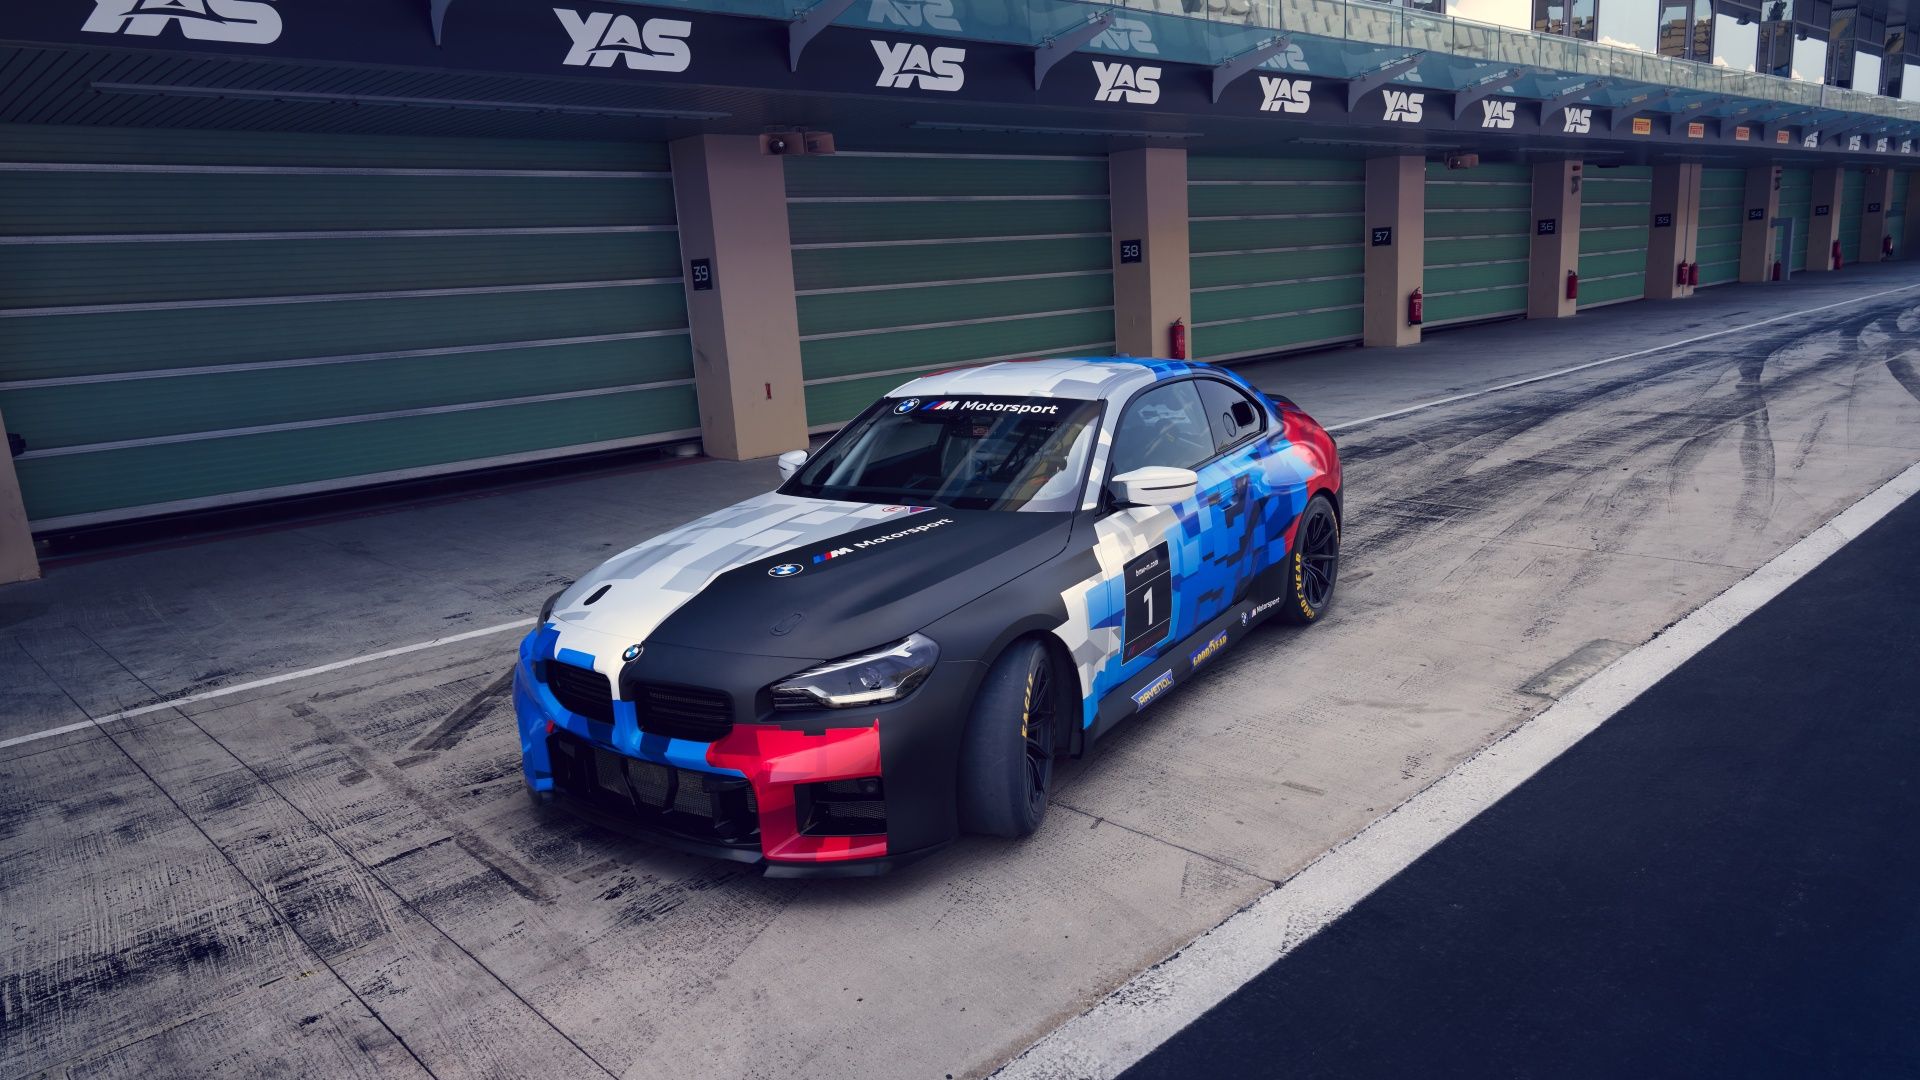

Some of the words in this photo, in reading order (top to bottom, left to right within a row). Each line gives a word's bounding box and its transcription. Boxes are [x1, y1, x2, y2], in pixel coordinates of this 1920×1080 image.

[552, 8, 692, 73] YAS
[870, 40, 966, 92] YAS
[1091, 60, 1162, 105] YAS
[1258, 76, 1312, 114] YAS
[1382, 89, 1425, 123] YAS
[1481, 99, 1516, 129] YAS
[1563, 107, 1592, 134] YAS
[1374, 231, 1390, 242] 37
[1539, 222, 1554, 231] 36
[1122, 245, 1139, 258] 38
[692, 265, 709, 282] 39
[961, 401, 1059, 415] Motorsport
[854, 517, 954, 549] Motorsport
[1143, 585, 1153, 626] 1
[1256, 597, 1280, 614] Motorsport
[1193, 634, 1228, 667] GOODYEAR
[1138, 677, 1173, 705] RAVENOL
